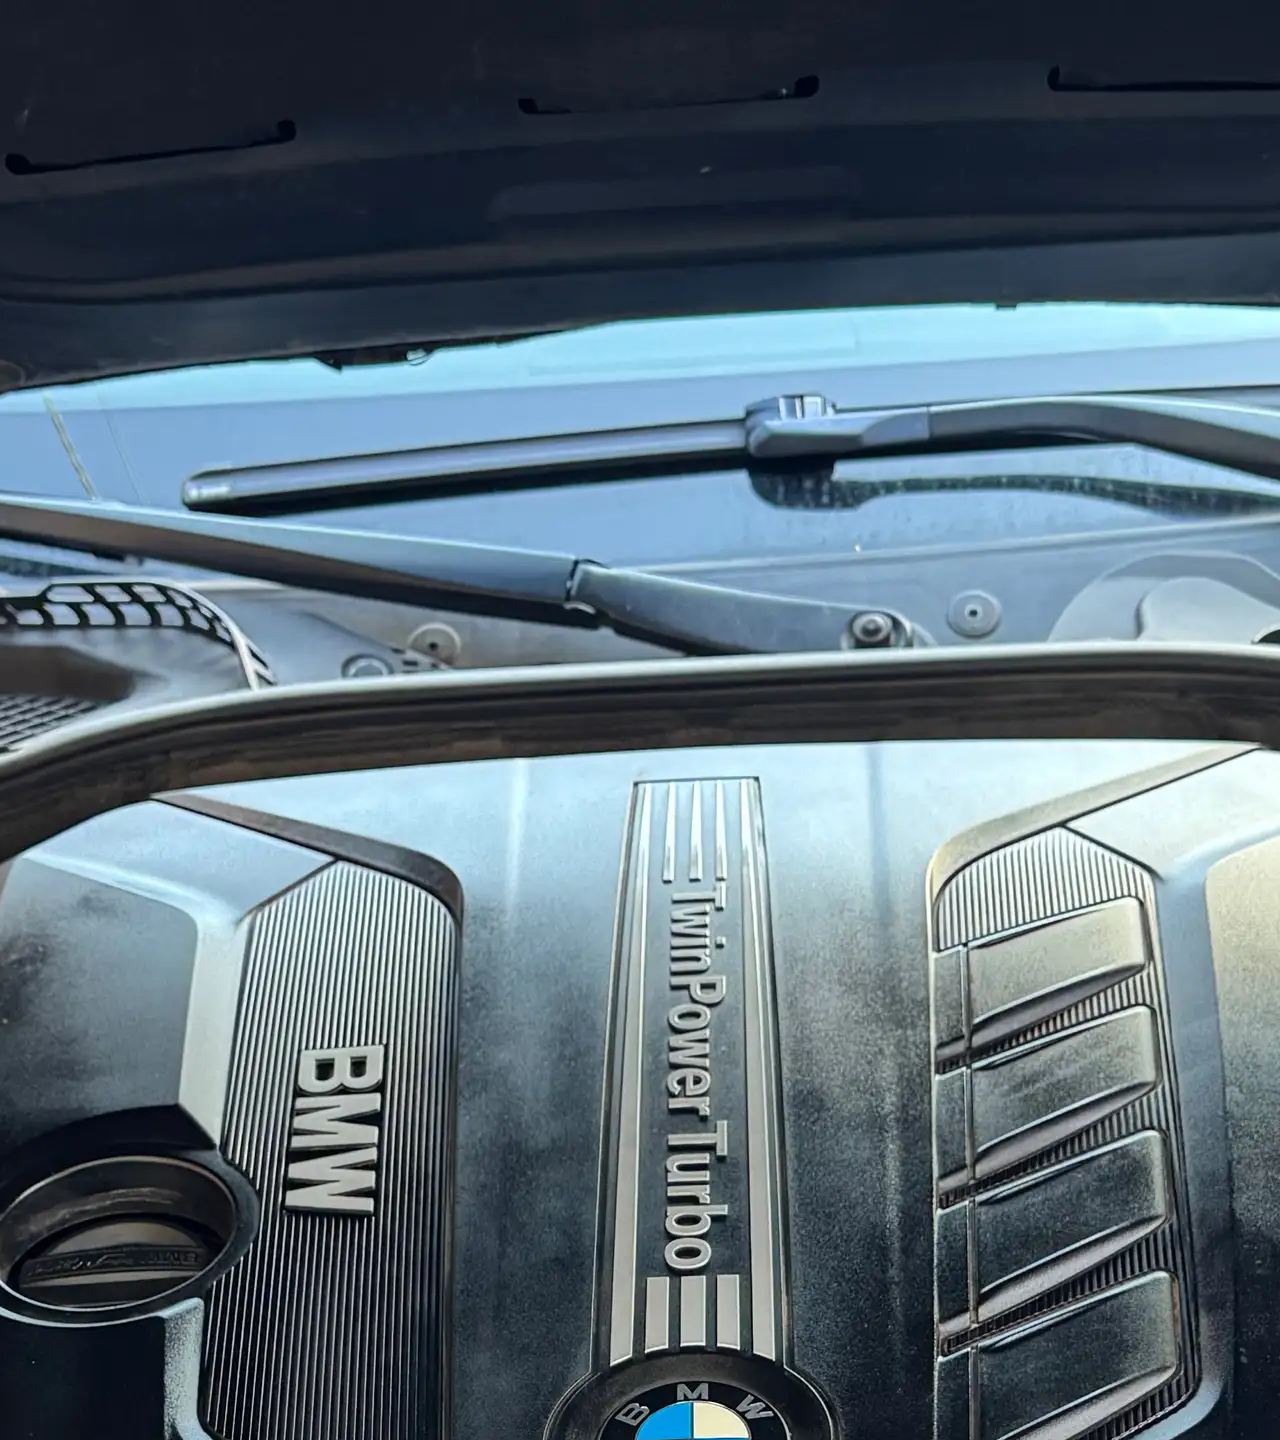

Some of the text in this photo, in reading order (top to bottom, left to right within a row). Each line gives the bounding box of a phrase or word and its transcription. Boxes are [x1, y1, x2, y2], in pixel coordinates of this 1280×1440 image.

[284, 1044, 385, 1215] BMW
[664, 882, 729, 1272] TwinPower Turbo
[615, 1382, 776, 1427] BMW
